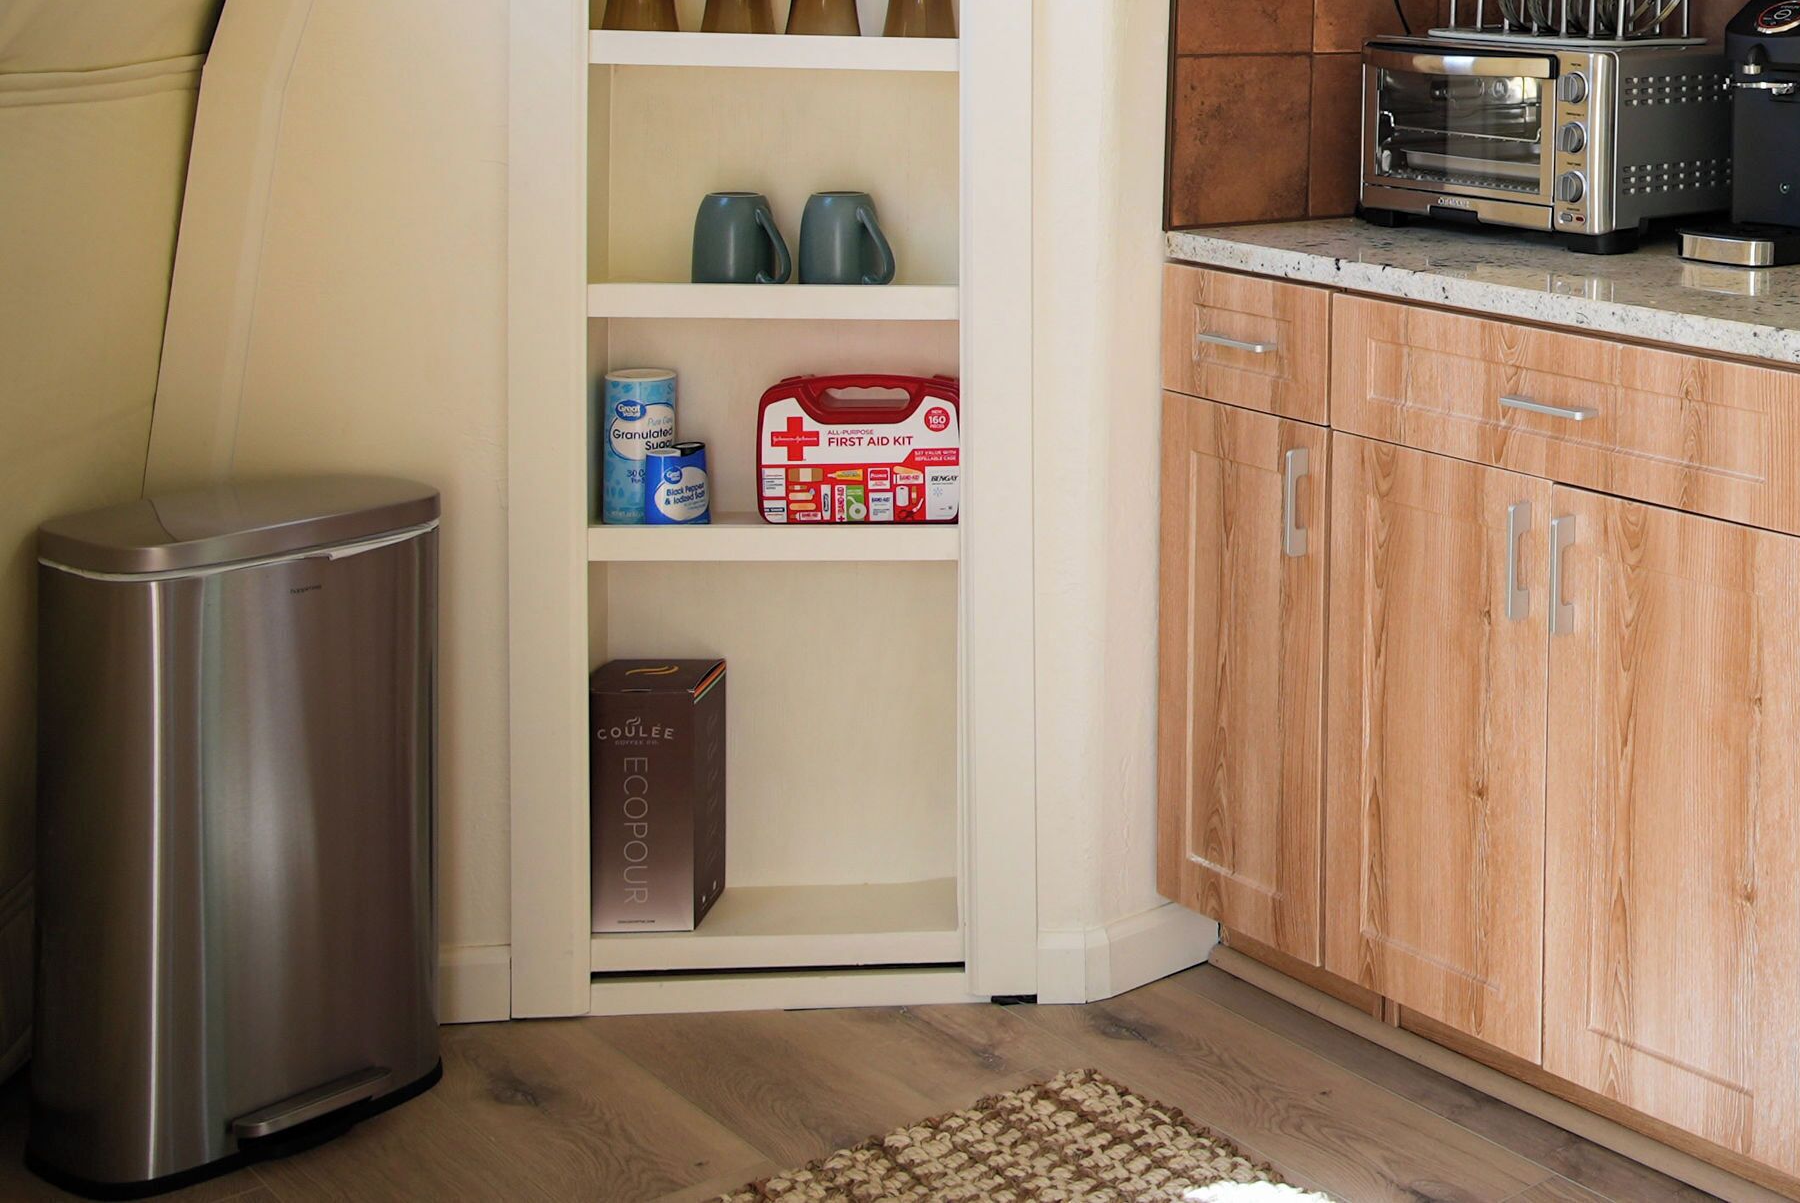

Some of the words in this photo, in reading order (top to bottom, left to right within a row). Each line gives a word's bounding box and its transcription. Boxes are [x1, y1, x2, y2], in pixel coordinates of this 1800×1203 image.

[929, 415, 946, 424] 160
[612, 427, 673, 440] Granulated
[828, 437, 864, 446] FIRST
[867, 436, 890, 446] AID
[893, 436, 913, 446] KIT
[666, 486, 683, 496] Black
[624, 758, 648, 904] ECOPOUR
